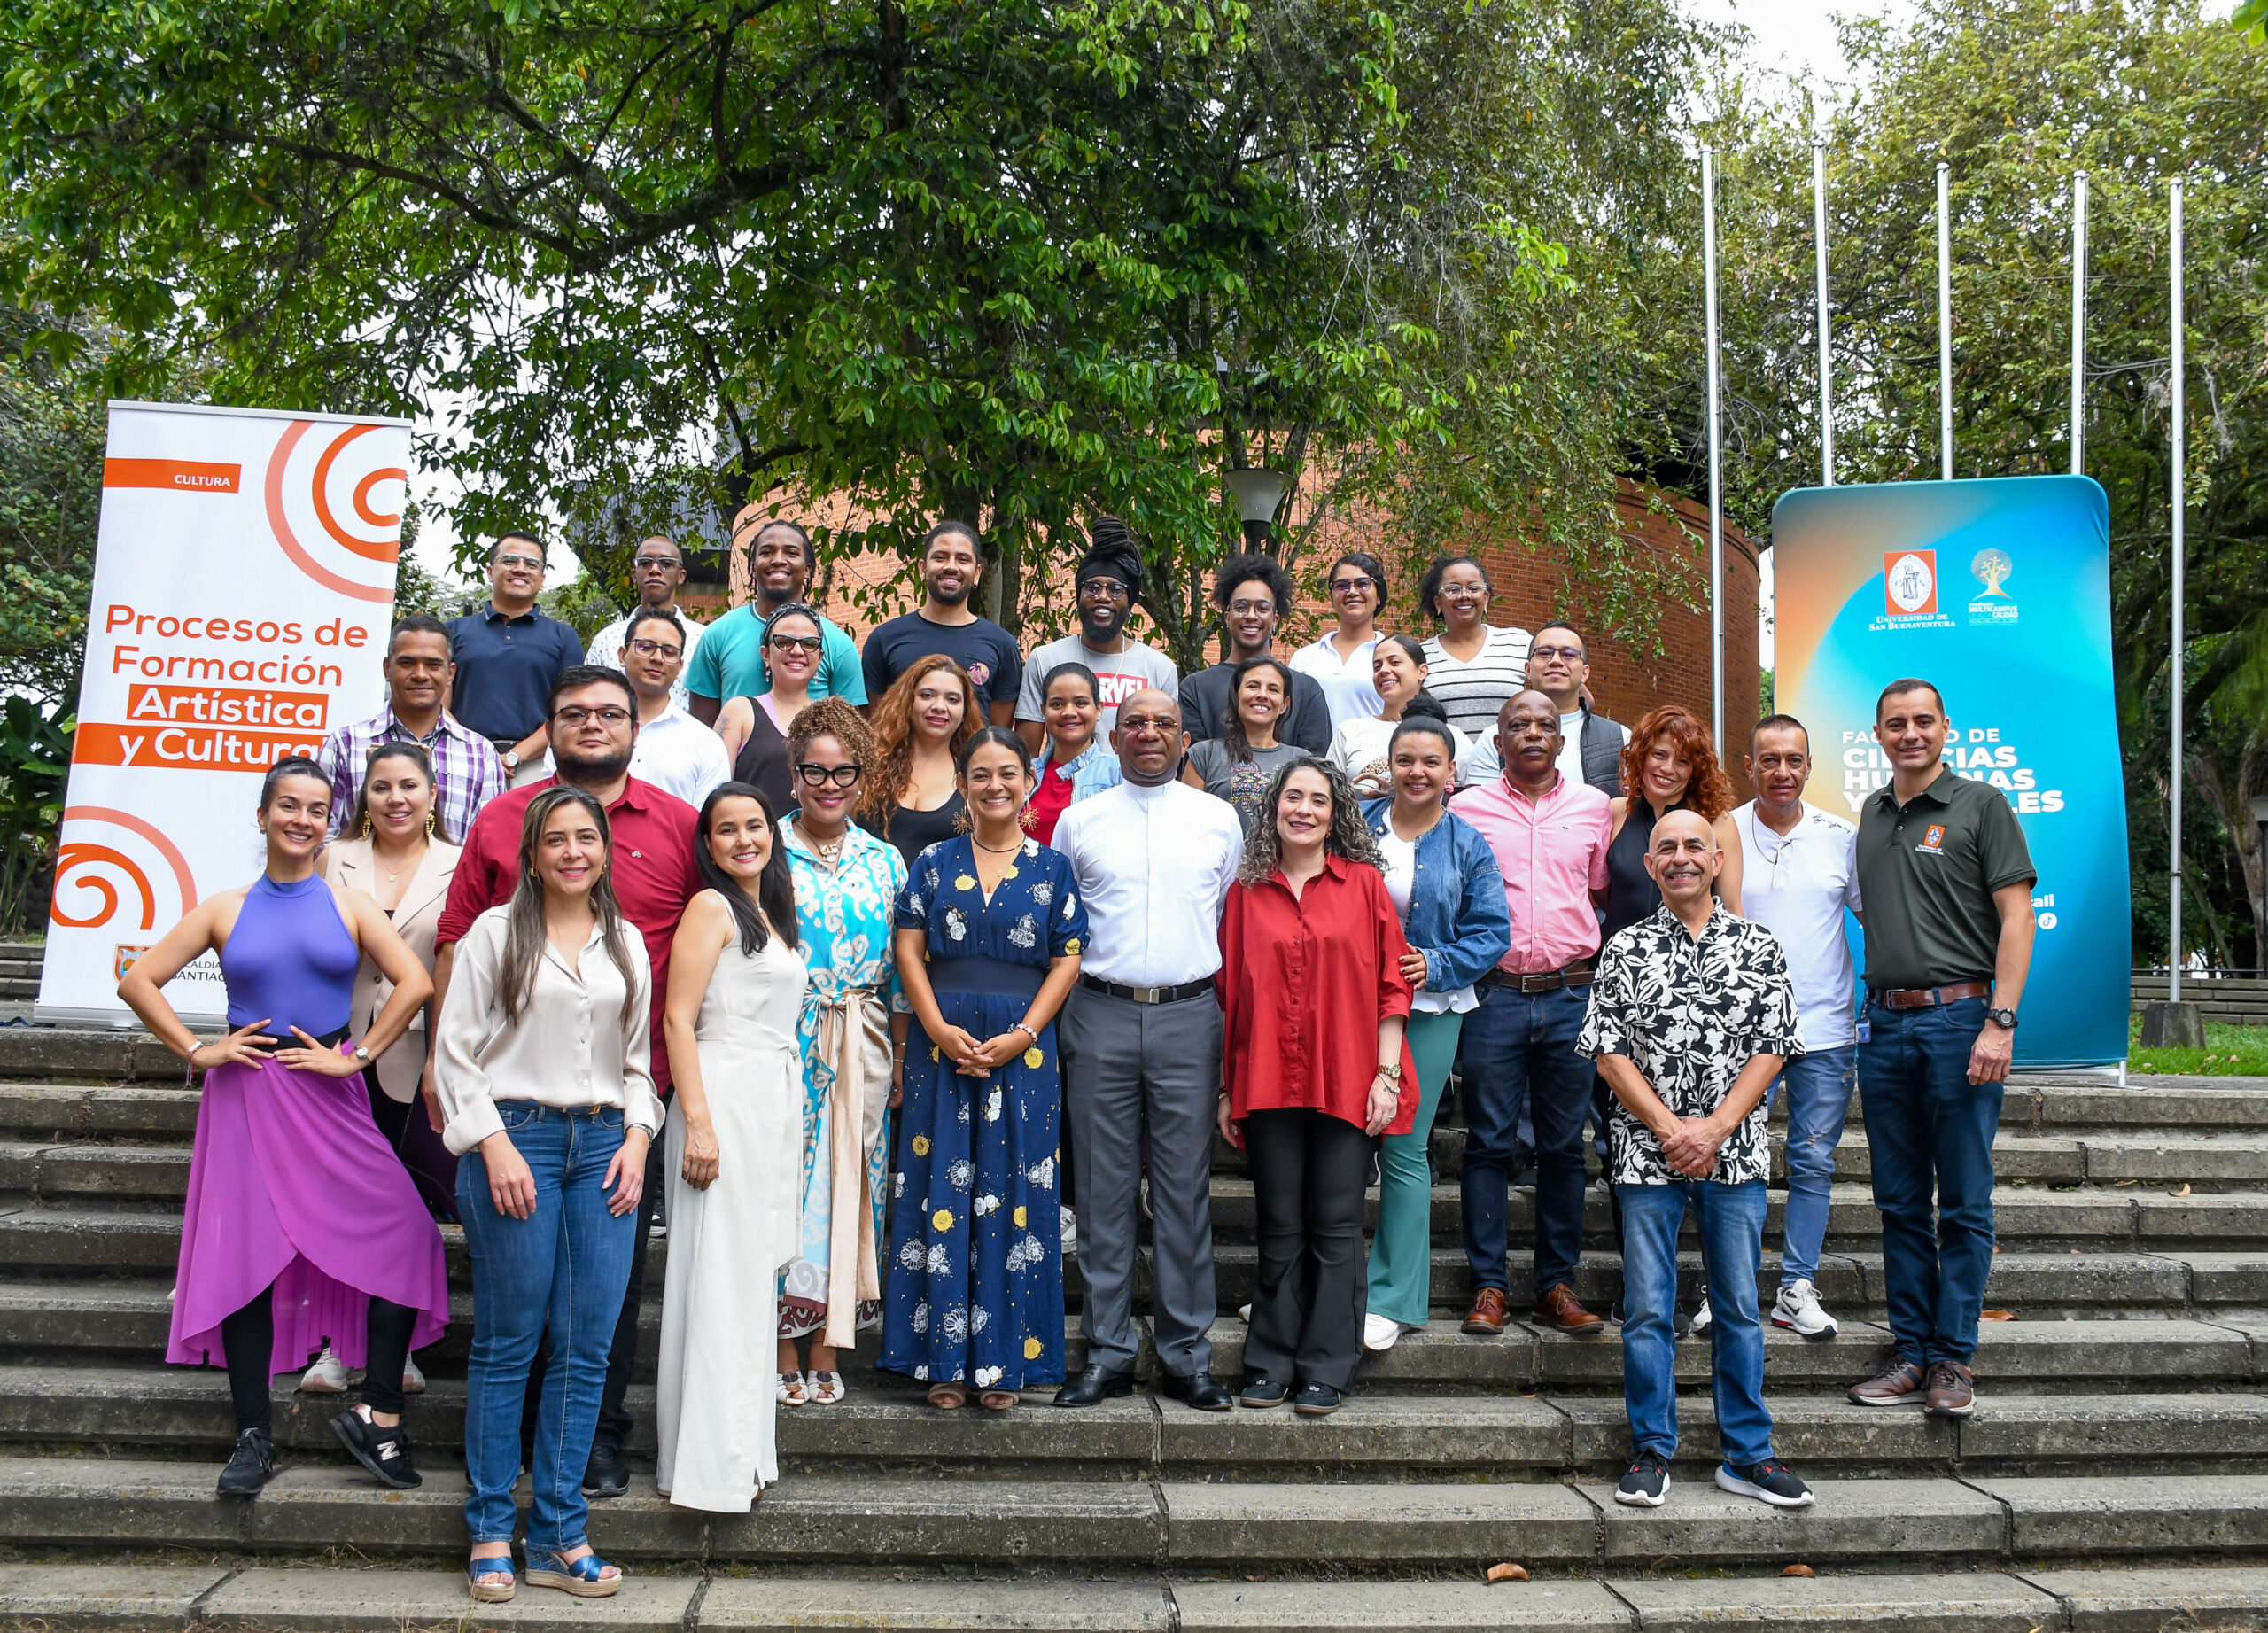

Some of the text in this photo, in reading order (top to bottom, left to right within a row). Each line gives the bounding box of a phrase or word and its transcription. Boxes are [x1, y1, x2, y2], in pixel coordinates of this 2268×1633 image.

[174, 474, 231, 487] CULTURA
[105, 603, 369, 648] Procesos de
[1868, 620, 1956, 632] SAN BUENAVENTURA
[1876, 614, 1935, 624] UNIVERSIDAD
[112, 644, 343, 687] Formación
[131, 687, 323, 727] Artística
[1969, 727, 2000, 743] DE
[119, 727, 329, 766] y Cultura
[1842, 791, 1867, 813] Y
